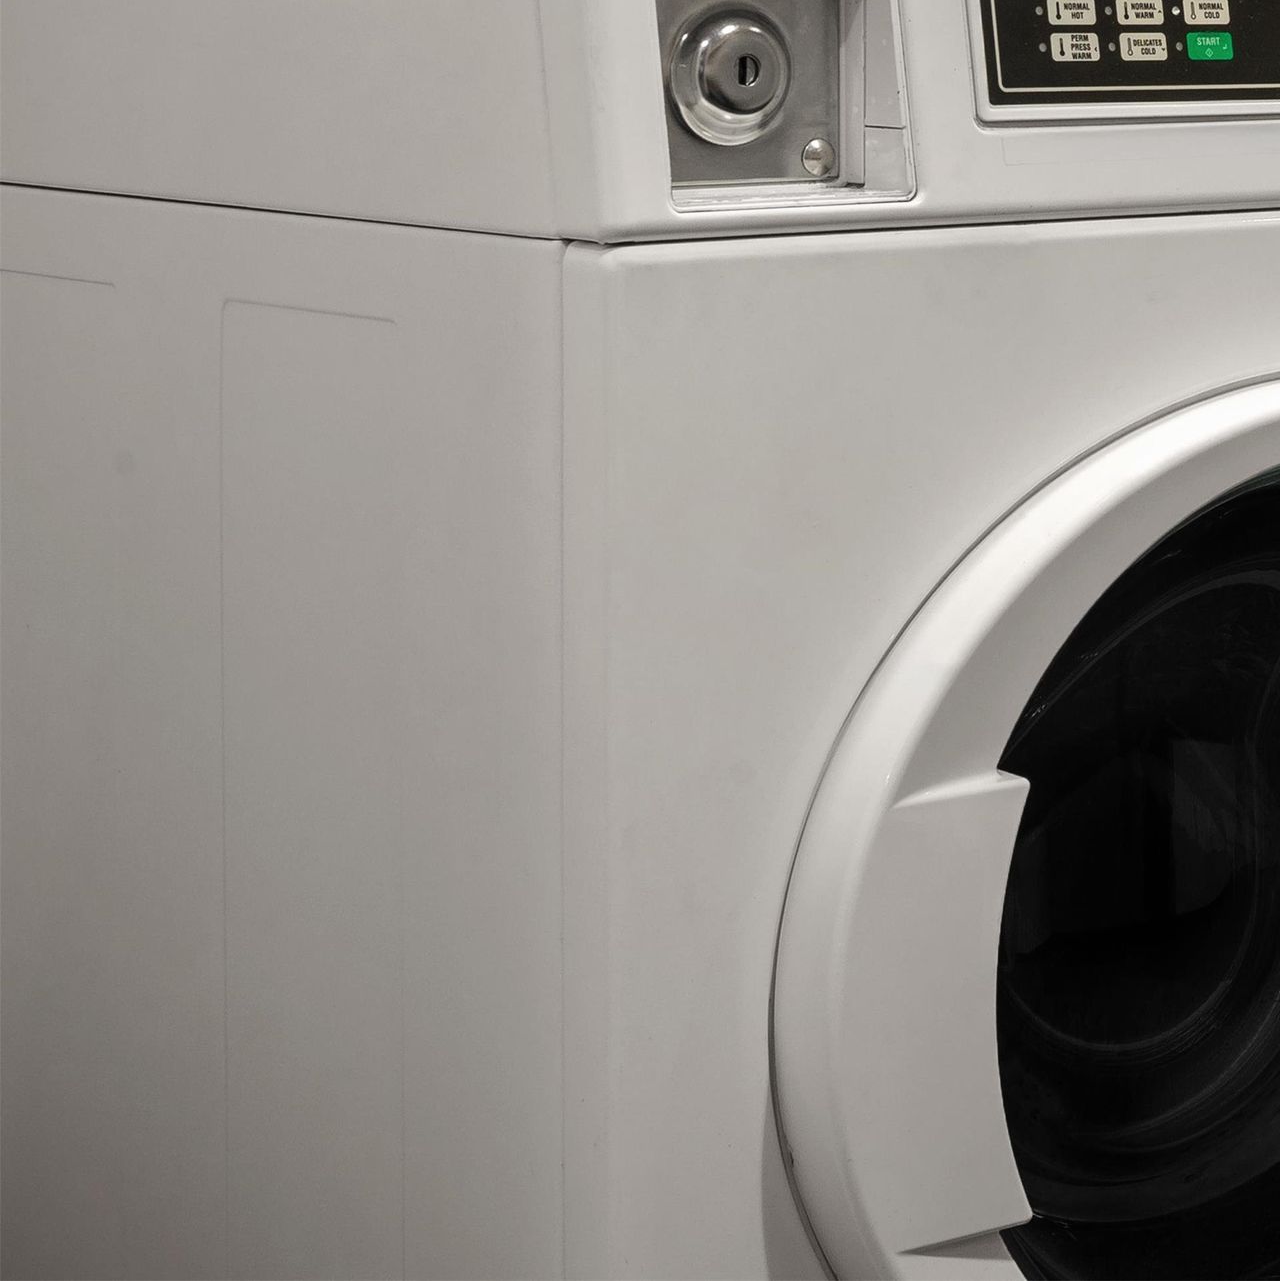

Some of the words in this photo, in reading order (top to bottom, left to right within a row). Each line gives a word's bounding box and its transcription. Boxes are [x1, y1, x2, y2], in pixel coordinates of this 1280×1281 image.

[1063, 3, 1090, 11] NORMAL
[1130, 3, 1157, 11] NORMAL
[1198, 3, 1224, 11] NORMAL
[1071, 11, 1084, 19] HOT
[1134, 11, 1155, 19] WARM
[1204, 11, 1220, 19] COLD
[1133, 39, 1162, 47] DELICATES
[1196, 37, 1220, 46] START
[1070, 43, 1091, 51] PRESS
[1071, 52, 1092, 60] WARM
